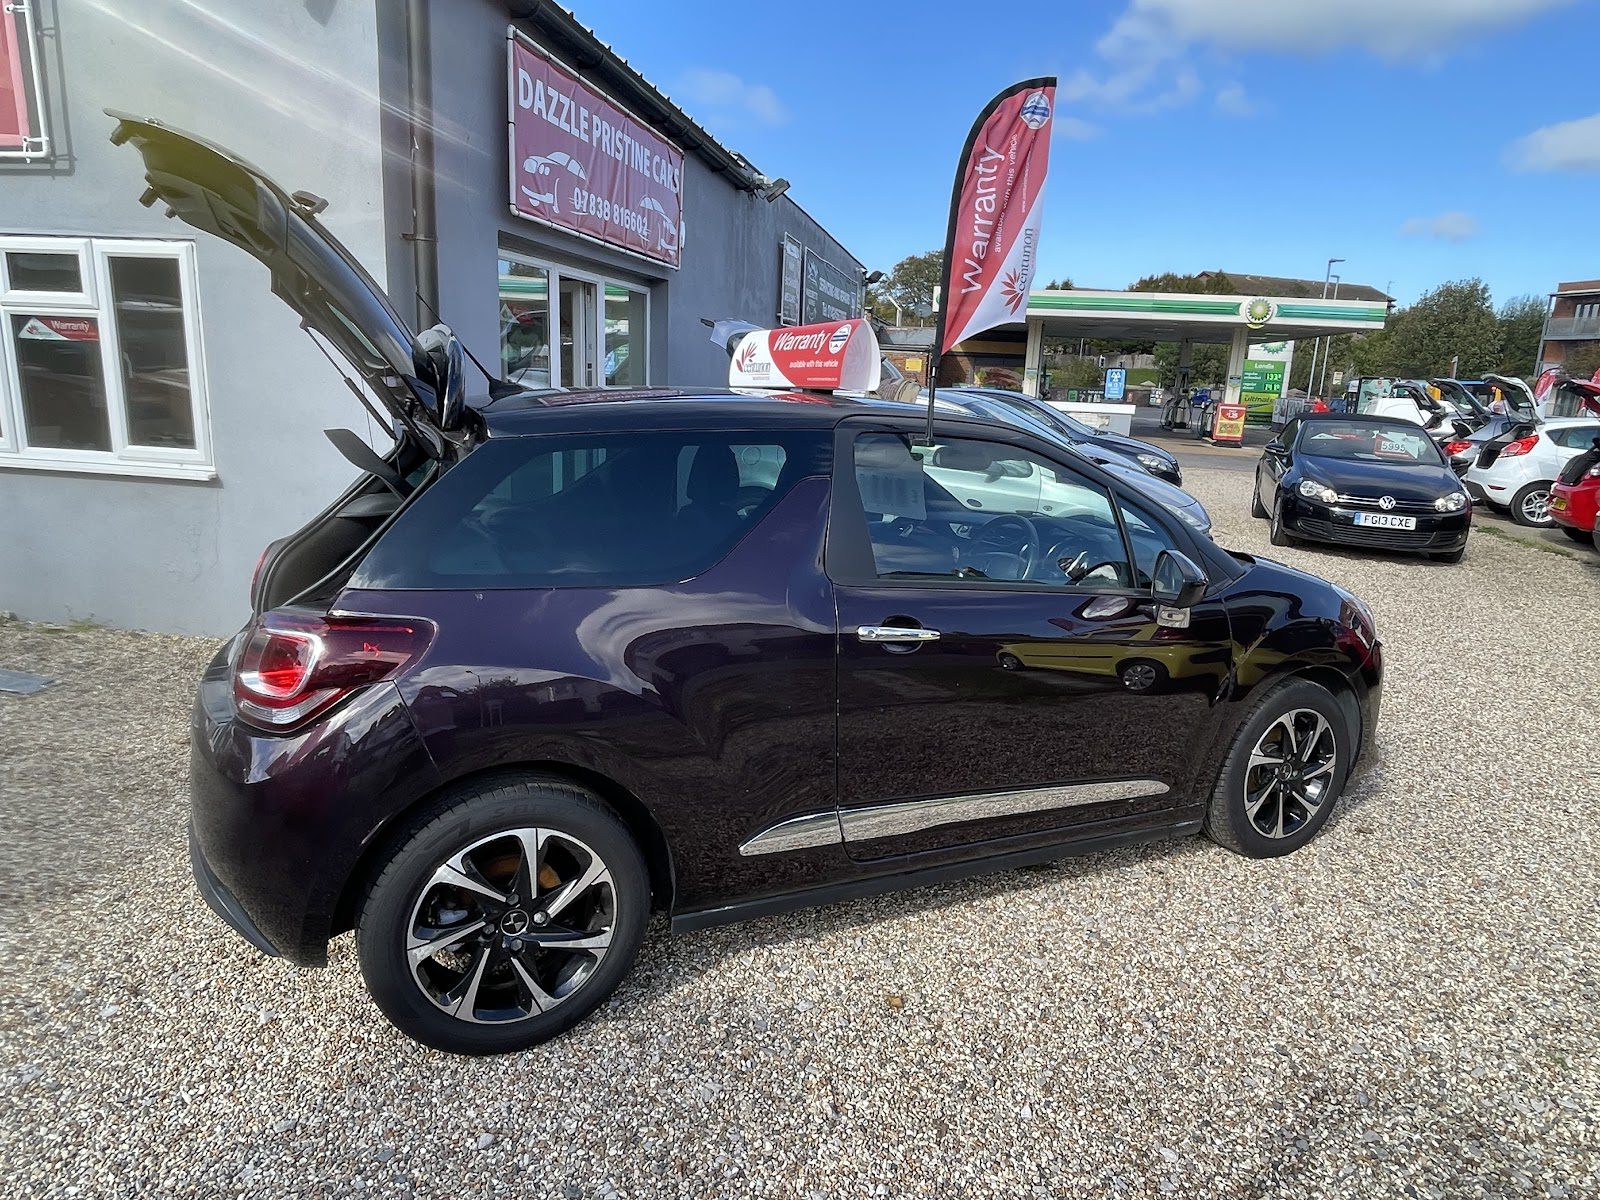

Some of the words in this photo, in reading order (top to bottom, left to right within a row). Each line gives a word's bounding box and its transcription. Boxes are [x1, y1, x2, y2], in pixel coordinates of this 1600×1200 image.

[517, 67, 590, 143] DAZZLE
[592, 114, 651, 178] PRISTINE
[652, 155, 680, 194] CARS
[1008, 133, 1018, 166] vehicle
[1006, 166, 1015, 186] this
[573, 186, 611, 221] 07838
[1003, 187, 1011, 209] with
[960, 143, 1005, 295] Warranty
[994, 211, 1006, 253] available
[50, 319, 90, 333] Warranty
[773, 330, 832, 354] Warranty
[815, 359, 823, 368] this
[823, 359, 839, 368] vehicle
[1382, 442, 1406, 452] 5995
[1364, 515, 1388, 526] FG13
[1390, 517, 1411, 528] CXE
